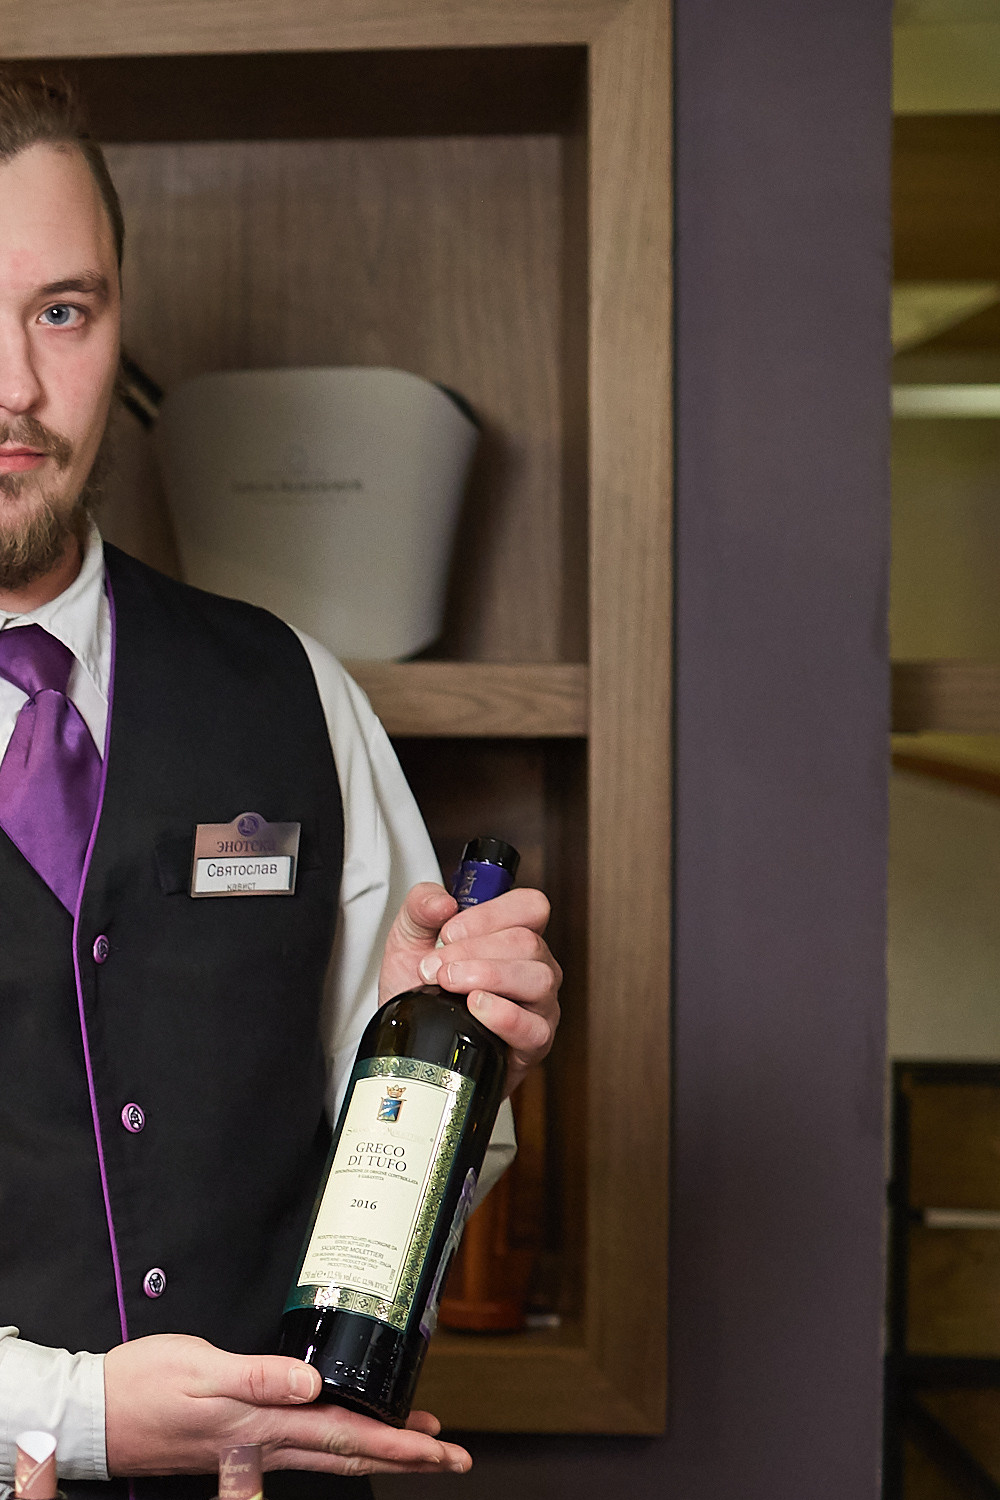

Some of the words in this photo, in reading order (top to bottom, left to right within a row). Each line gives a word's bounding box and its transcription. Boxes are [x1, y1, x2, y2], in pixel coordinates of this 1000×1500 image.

[207, 862, 278, 877] Святослав
[355, 1141, 405, 1158] GRECO
[347, 1155, 363, 1166] DI
[367, 1155, 407, 1172] TUFO
[350, 1198, 378, 1211] 2016
